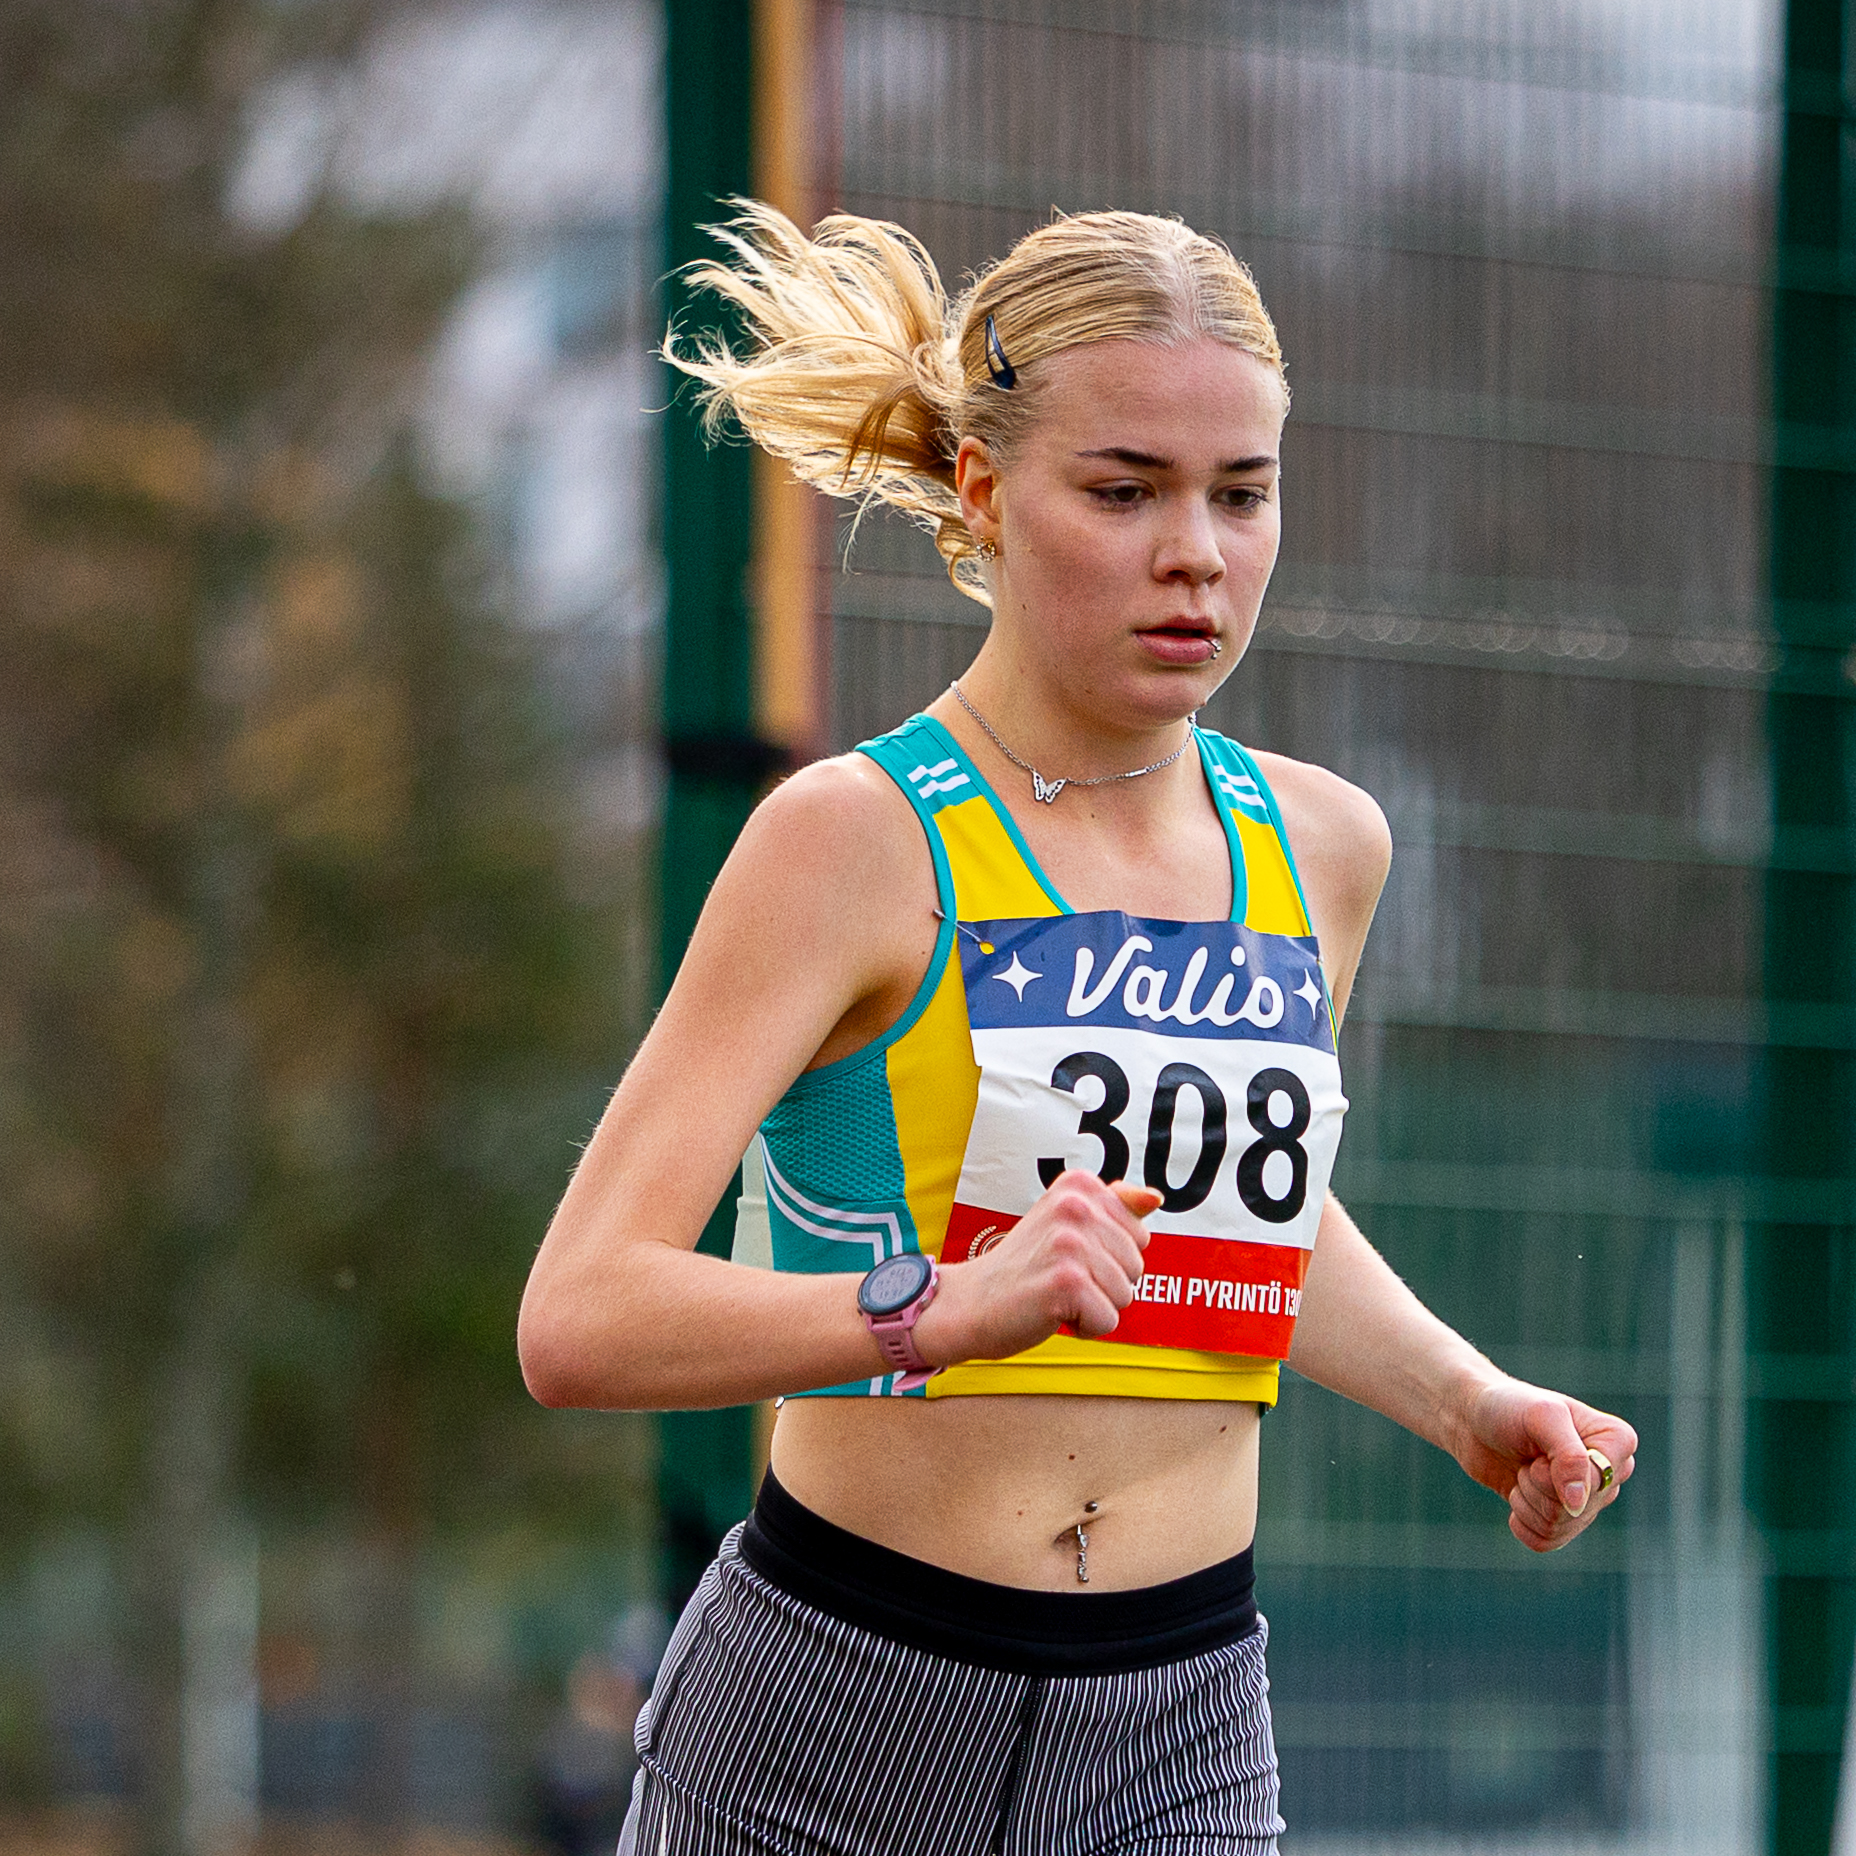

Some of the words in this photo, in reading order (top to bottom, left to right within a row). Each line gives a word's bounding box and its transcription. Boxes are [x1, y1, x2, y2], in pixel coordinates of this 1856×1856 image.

[1066, 935, 1285, 1029] Valio
[1037, 1051, 1312, 1224] 308
[1130, 1273, 1183, 1305] REEN
[1185, 1277, 1282, 1315] PYRINTÖ
